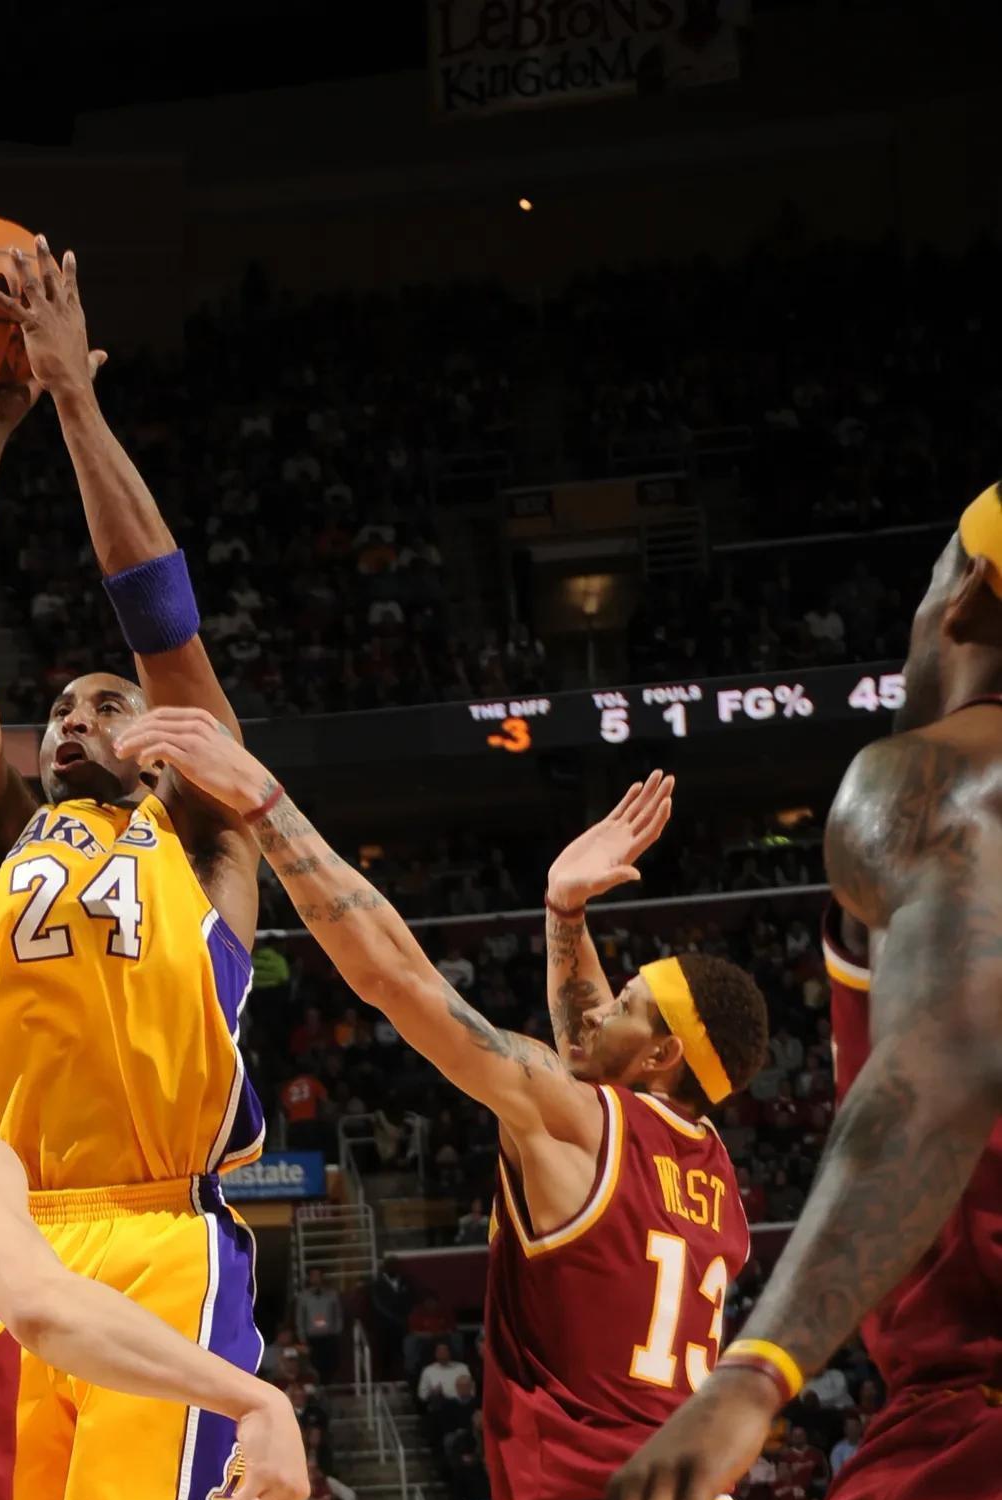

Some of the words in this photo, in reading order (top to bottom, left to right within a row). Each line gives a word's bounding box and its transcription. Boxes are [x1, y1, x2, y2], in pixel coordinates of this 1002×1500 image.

[717, 682, 814, 723] FG%
[848, 673, 907, 712] 45
[486, 716, 531, 752] -3
[600, 707, 630, 744] 5
[662, 702, 687, 738] 1
[9, 853, 144, 964] 24
[220, 1160, 305, 1187] llstate
[652, 1154, 726, 1233] WEST
[628, 1229, 729, 1394] 13
